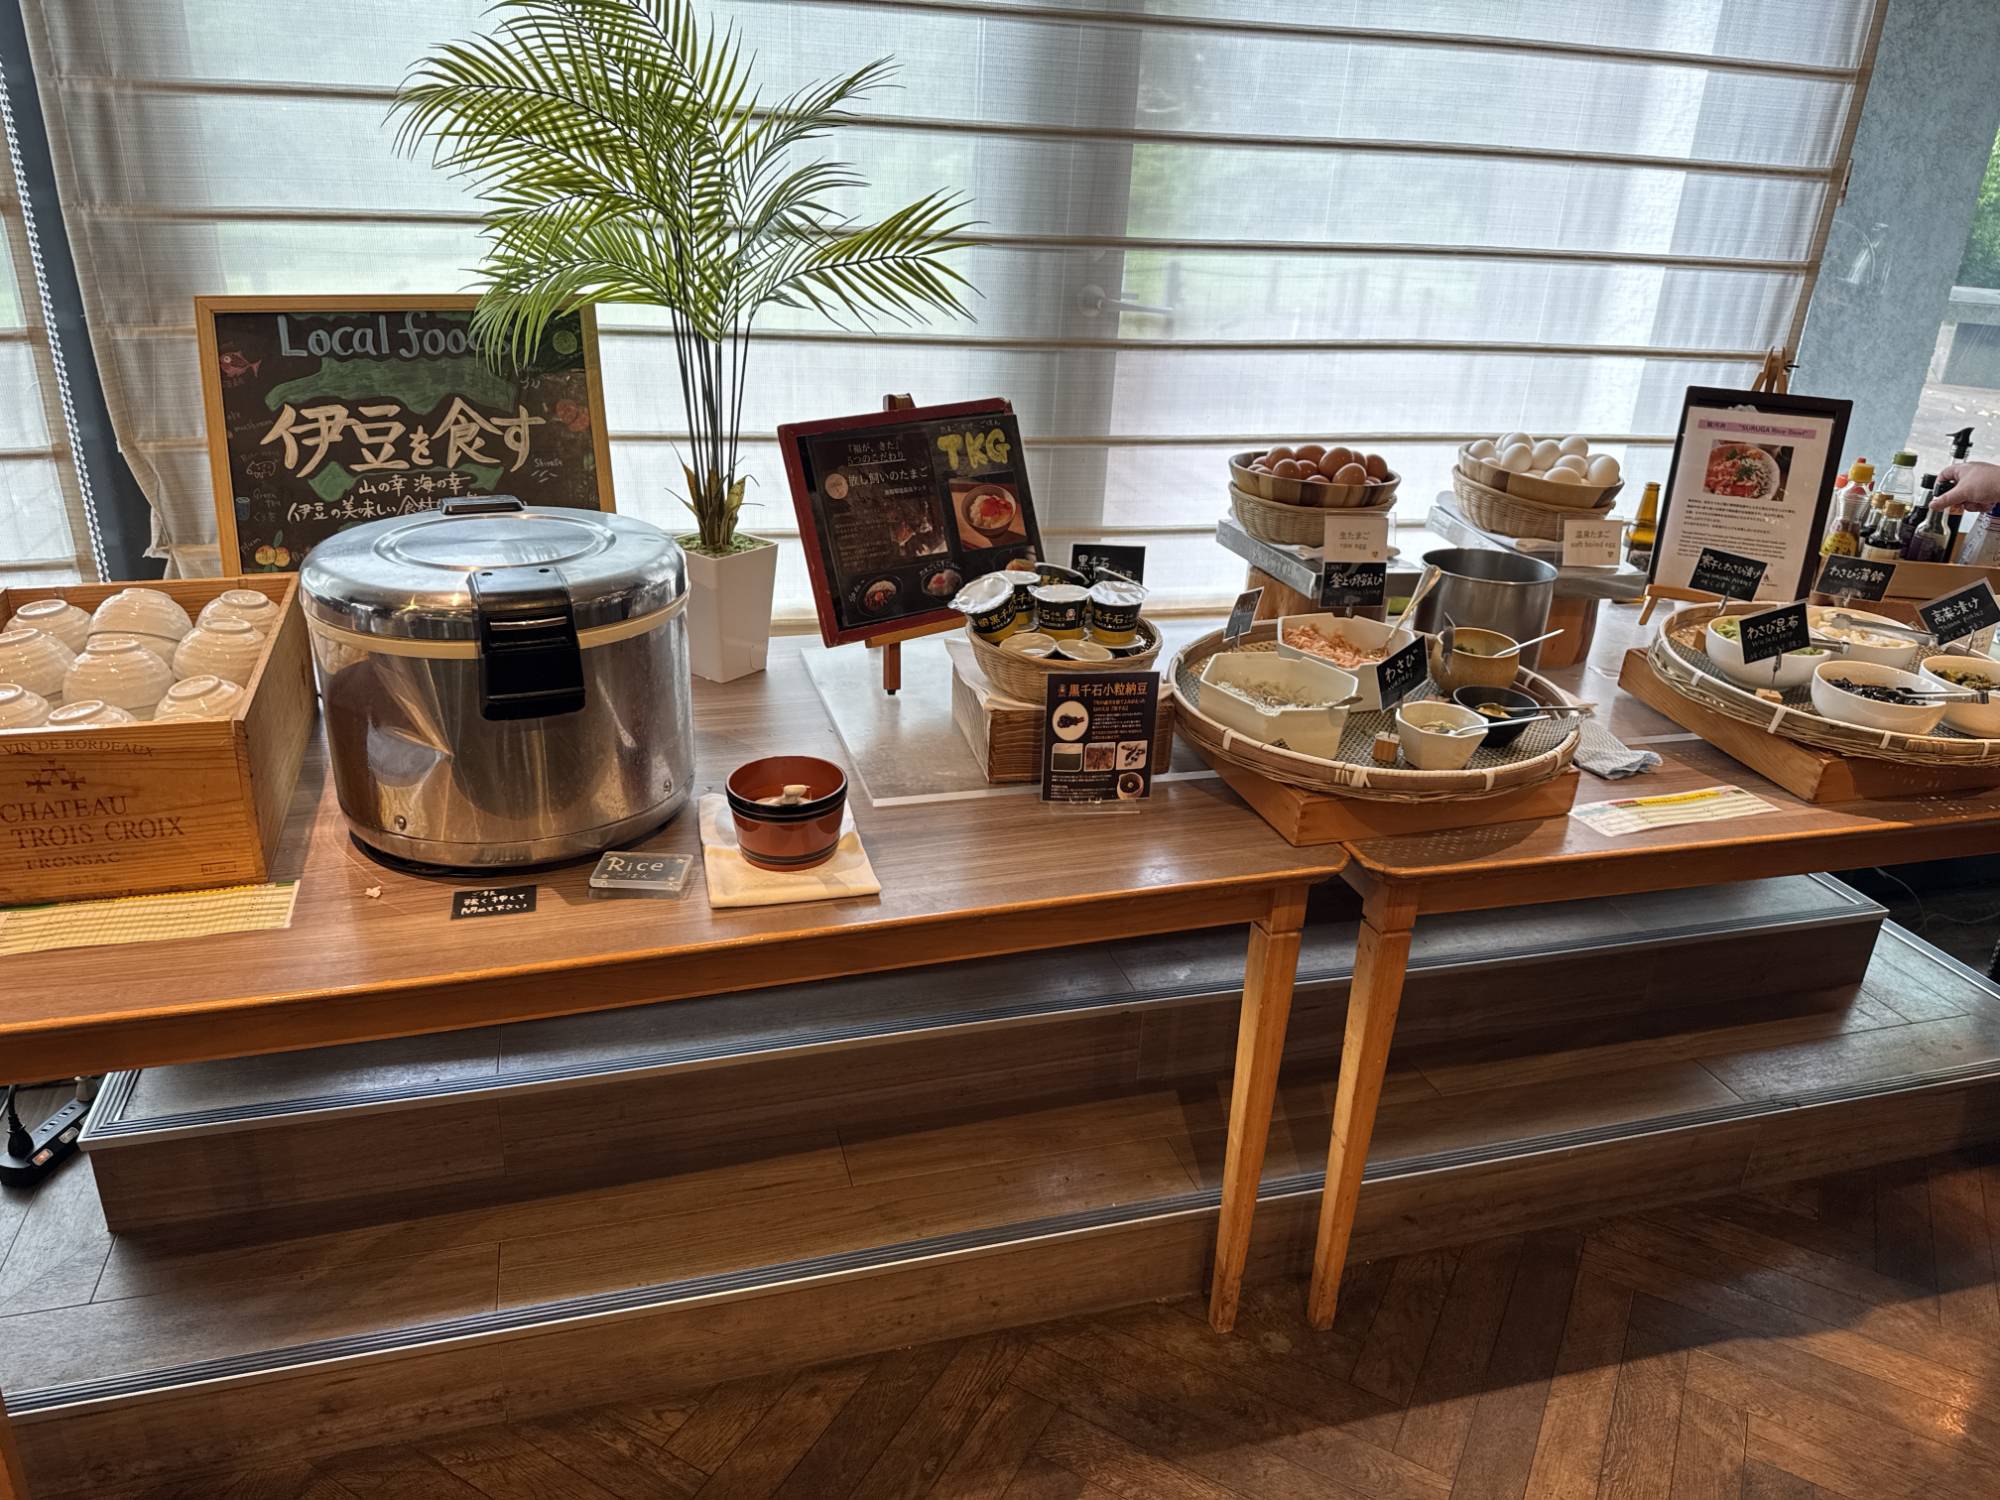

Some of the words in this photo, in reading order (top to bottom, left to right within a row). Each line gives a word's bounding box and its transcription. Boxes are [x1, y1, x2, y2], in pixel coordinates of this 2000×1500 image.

[277, 313, 391, 357] Local
[260, 397, 546, 477] 伊豆を食す
[937, 428, 1011, 470] TKG
[358, 473, 408, 496] 山の幸
[413, 472, 474, 496] 海の幸
[287, 494, 443, 522] 伊豆の美味しい食材
[1746, 615, 1799, 640] わさび昆布
[1385, 648, 1418, 683] わさび
[37, 740, 59, 751] DE
[64, 739, 153, 756] BORDEAUX
[1, 795, 129, 824] CHATEAU
[10, 823, 95, 850] TROIS
[104, 816, 185, 843] CROIX
[25, 852, 121, 870] FRONSAC
[606, 856, 664, 872] Rice
